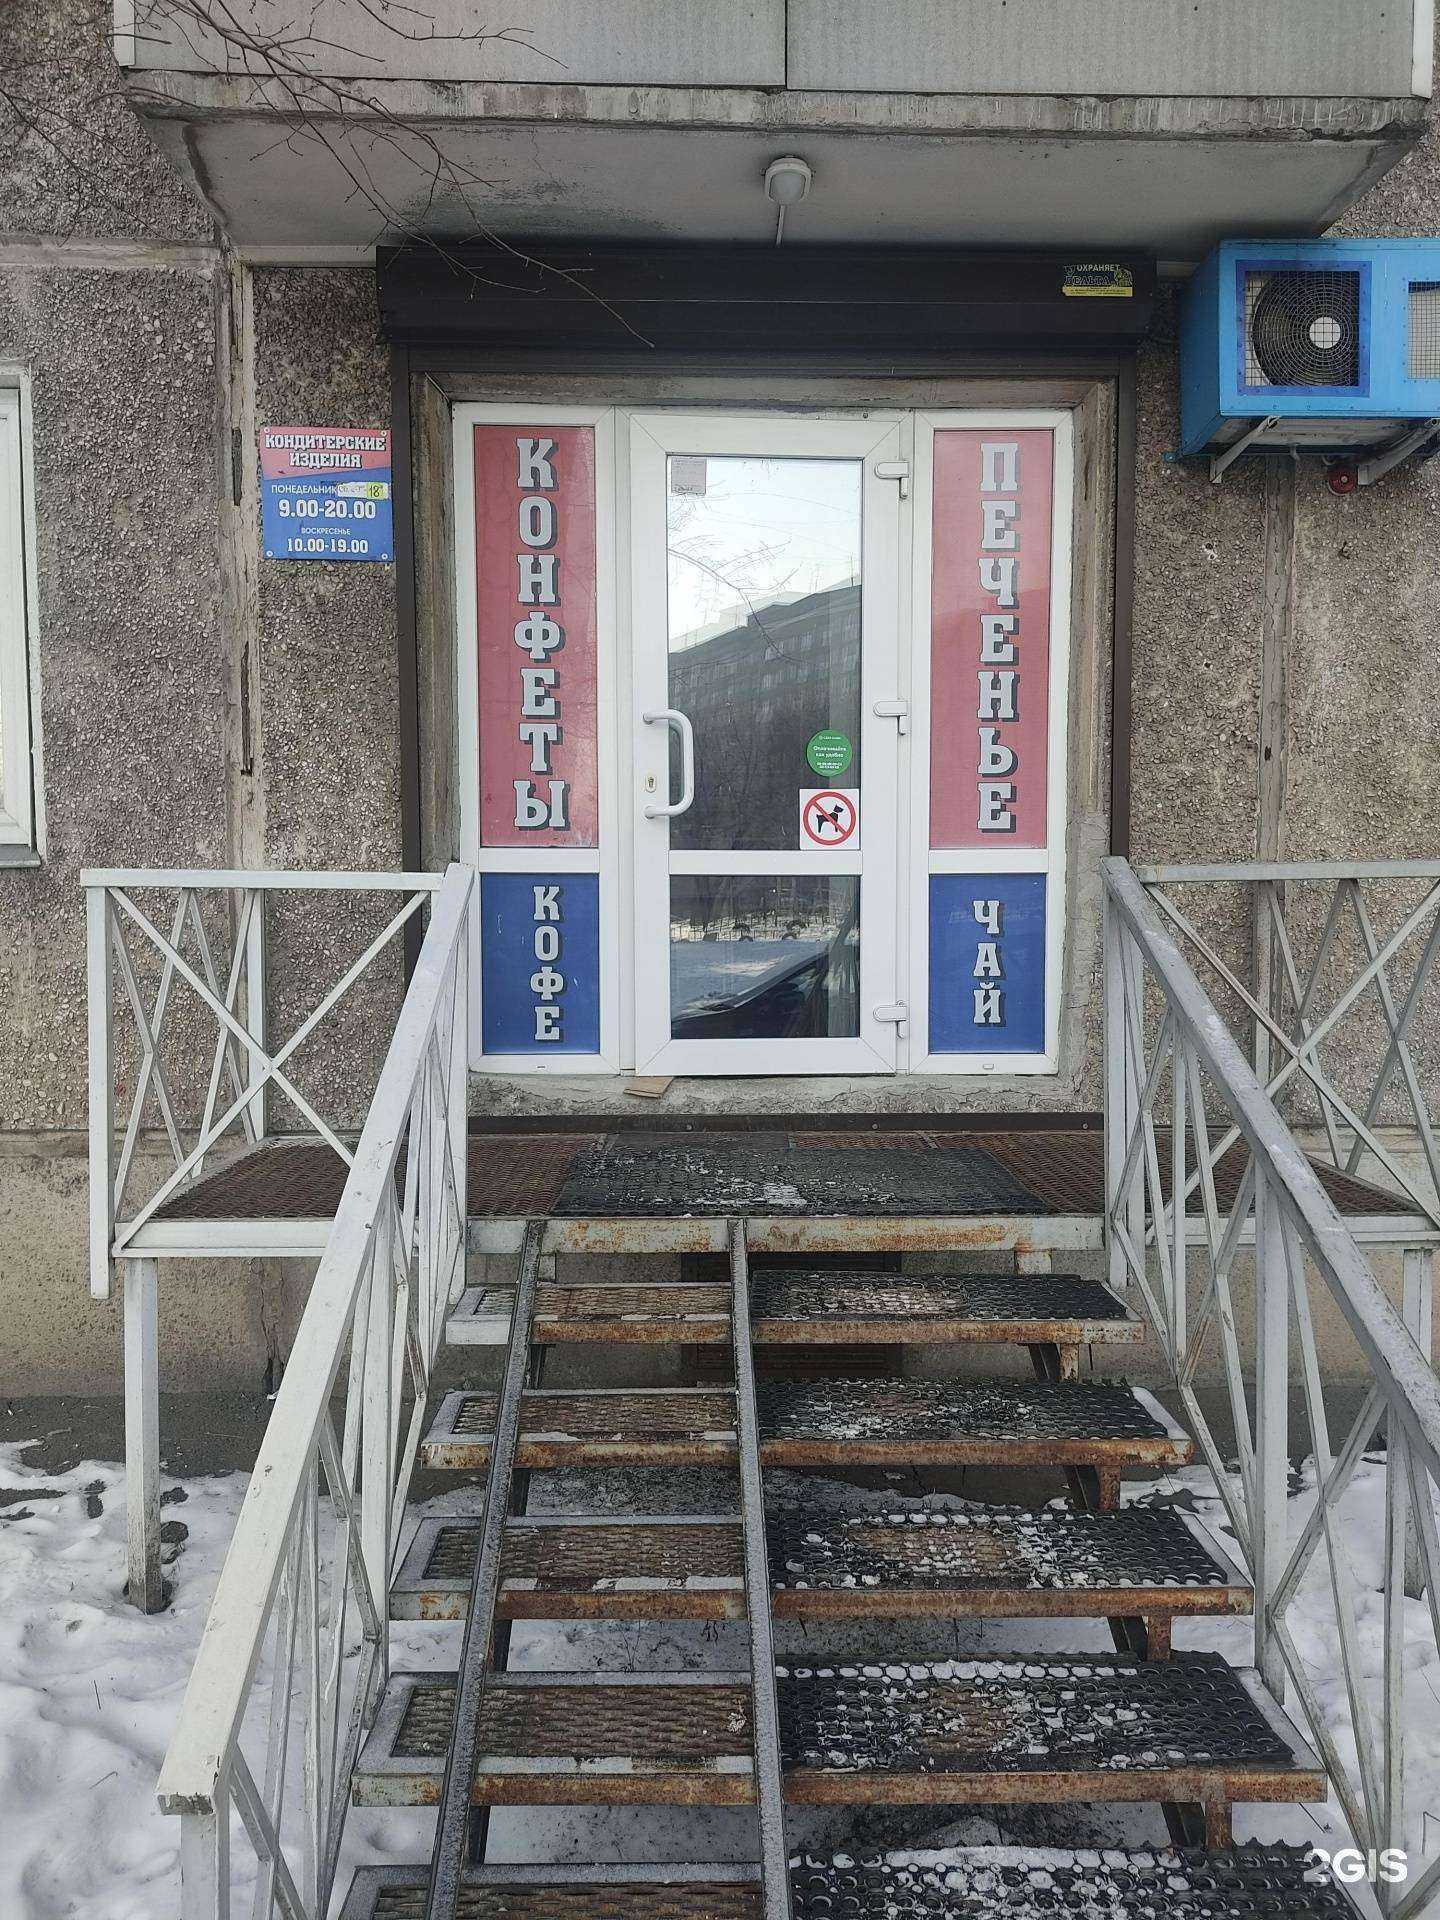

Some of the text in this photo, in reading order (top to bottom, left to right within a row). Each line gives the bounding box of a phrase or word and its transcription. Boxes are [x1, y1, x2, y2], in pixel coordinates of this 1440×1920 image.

[265, 434, 386, 451] КОНДИТЕРСКИЕ
[289, 452, 363, 468] ИЗДЕЛИЯ
[271, 484, 337, 495] ПОНЕДЕЛЬНИК
[279, 499, 376, 519] 9.00-20.00
[301, 527, 351, 536] ВОСКРЕСЕНЬЕ
[287, 538, 369, 554] 10.00-19.00
[513, 437, 569, 831] КОНФЕТЫ
[976, 442, 1019, 831] ПЕЧЕНЬЕ
[530, 886, 565, 1041] КОФЕ
[973, 900, 1003, 1025] ЧАЙ
